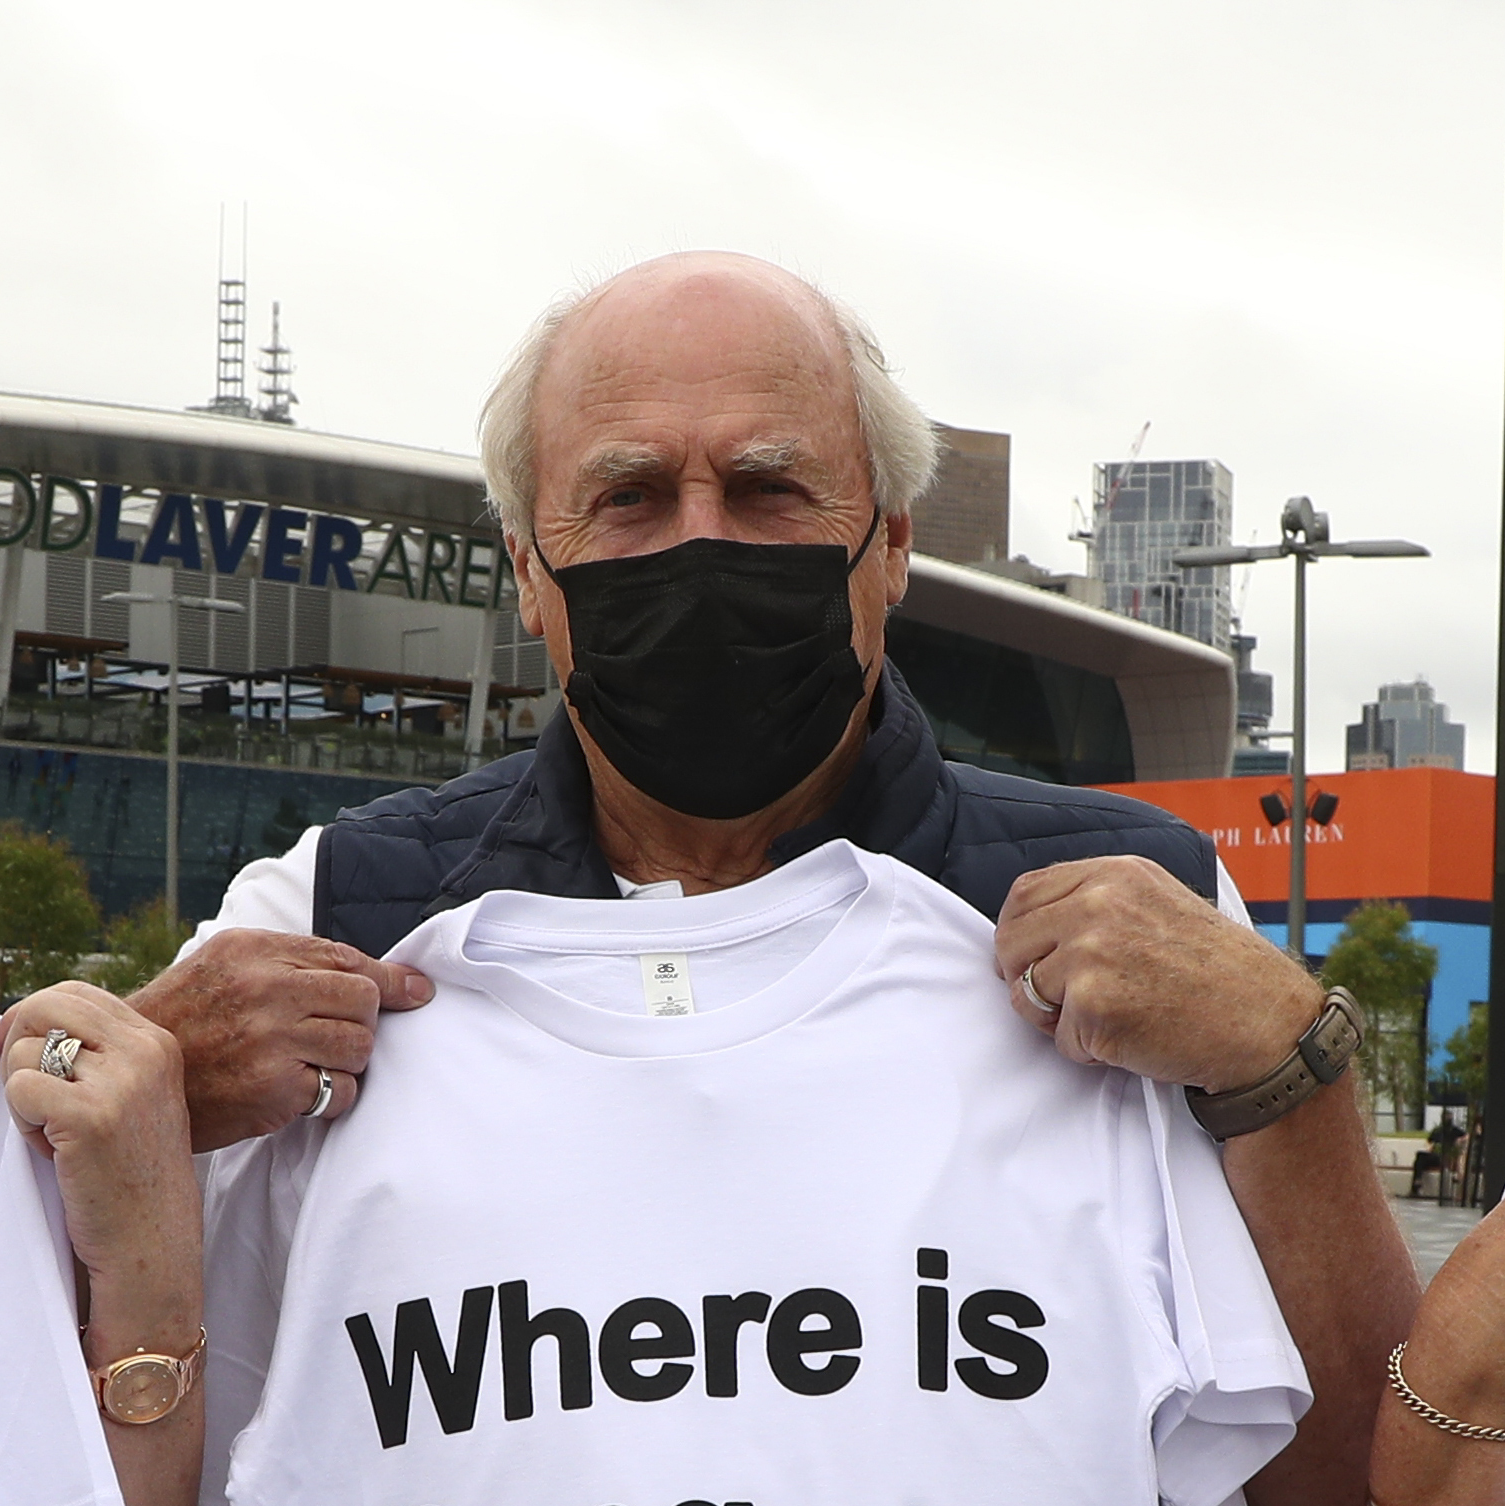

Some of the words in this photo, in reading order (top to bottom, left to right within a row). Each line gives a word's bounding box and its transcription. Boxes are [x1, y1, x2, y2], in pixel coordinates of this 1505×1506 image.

[96, 484, 362, 591] LAVER
[345, 1280, 862, 1449] Where
[916, 1247, 1050, 1400] is
